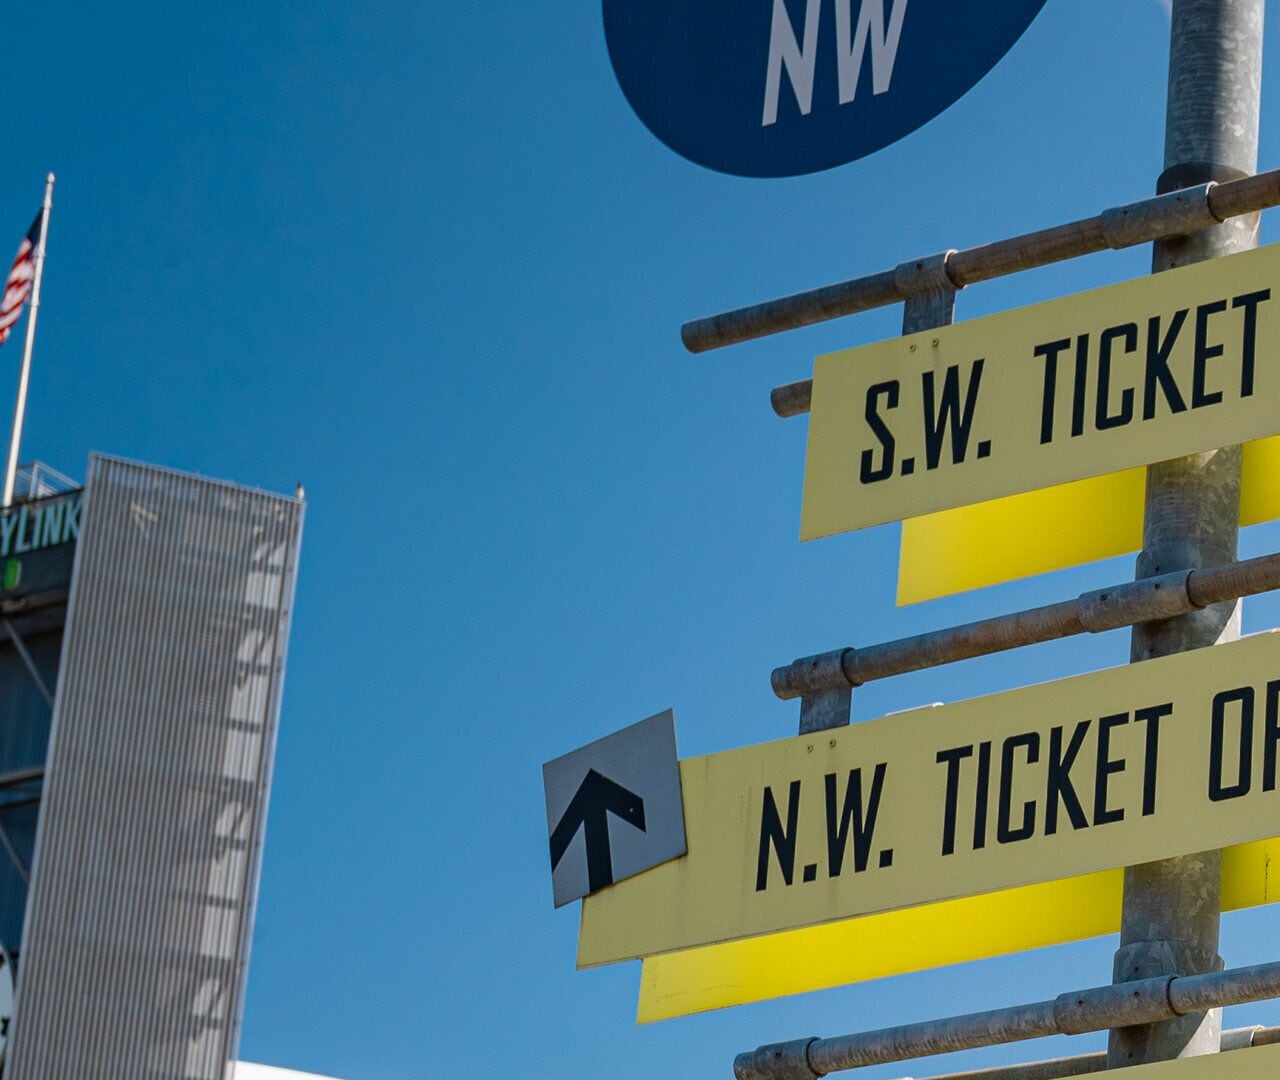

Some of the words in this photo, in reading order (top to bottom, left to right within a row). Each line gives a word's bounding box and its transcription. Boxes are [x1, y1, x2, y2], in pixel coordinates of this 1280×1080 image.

[762, 0, 906, 127] NW
[859, 358, 992, 485] S.W.
[1033, 288, 1271, 445] TICKET
[755, 763, 894, 892] N.W.
[935, 702, 1174, 857] TICKET
